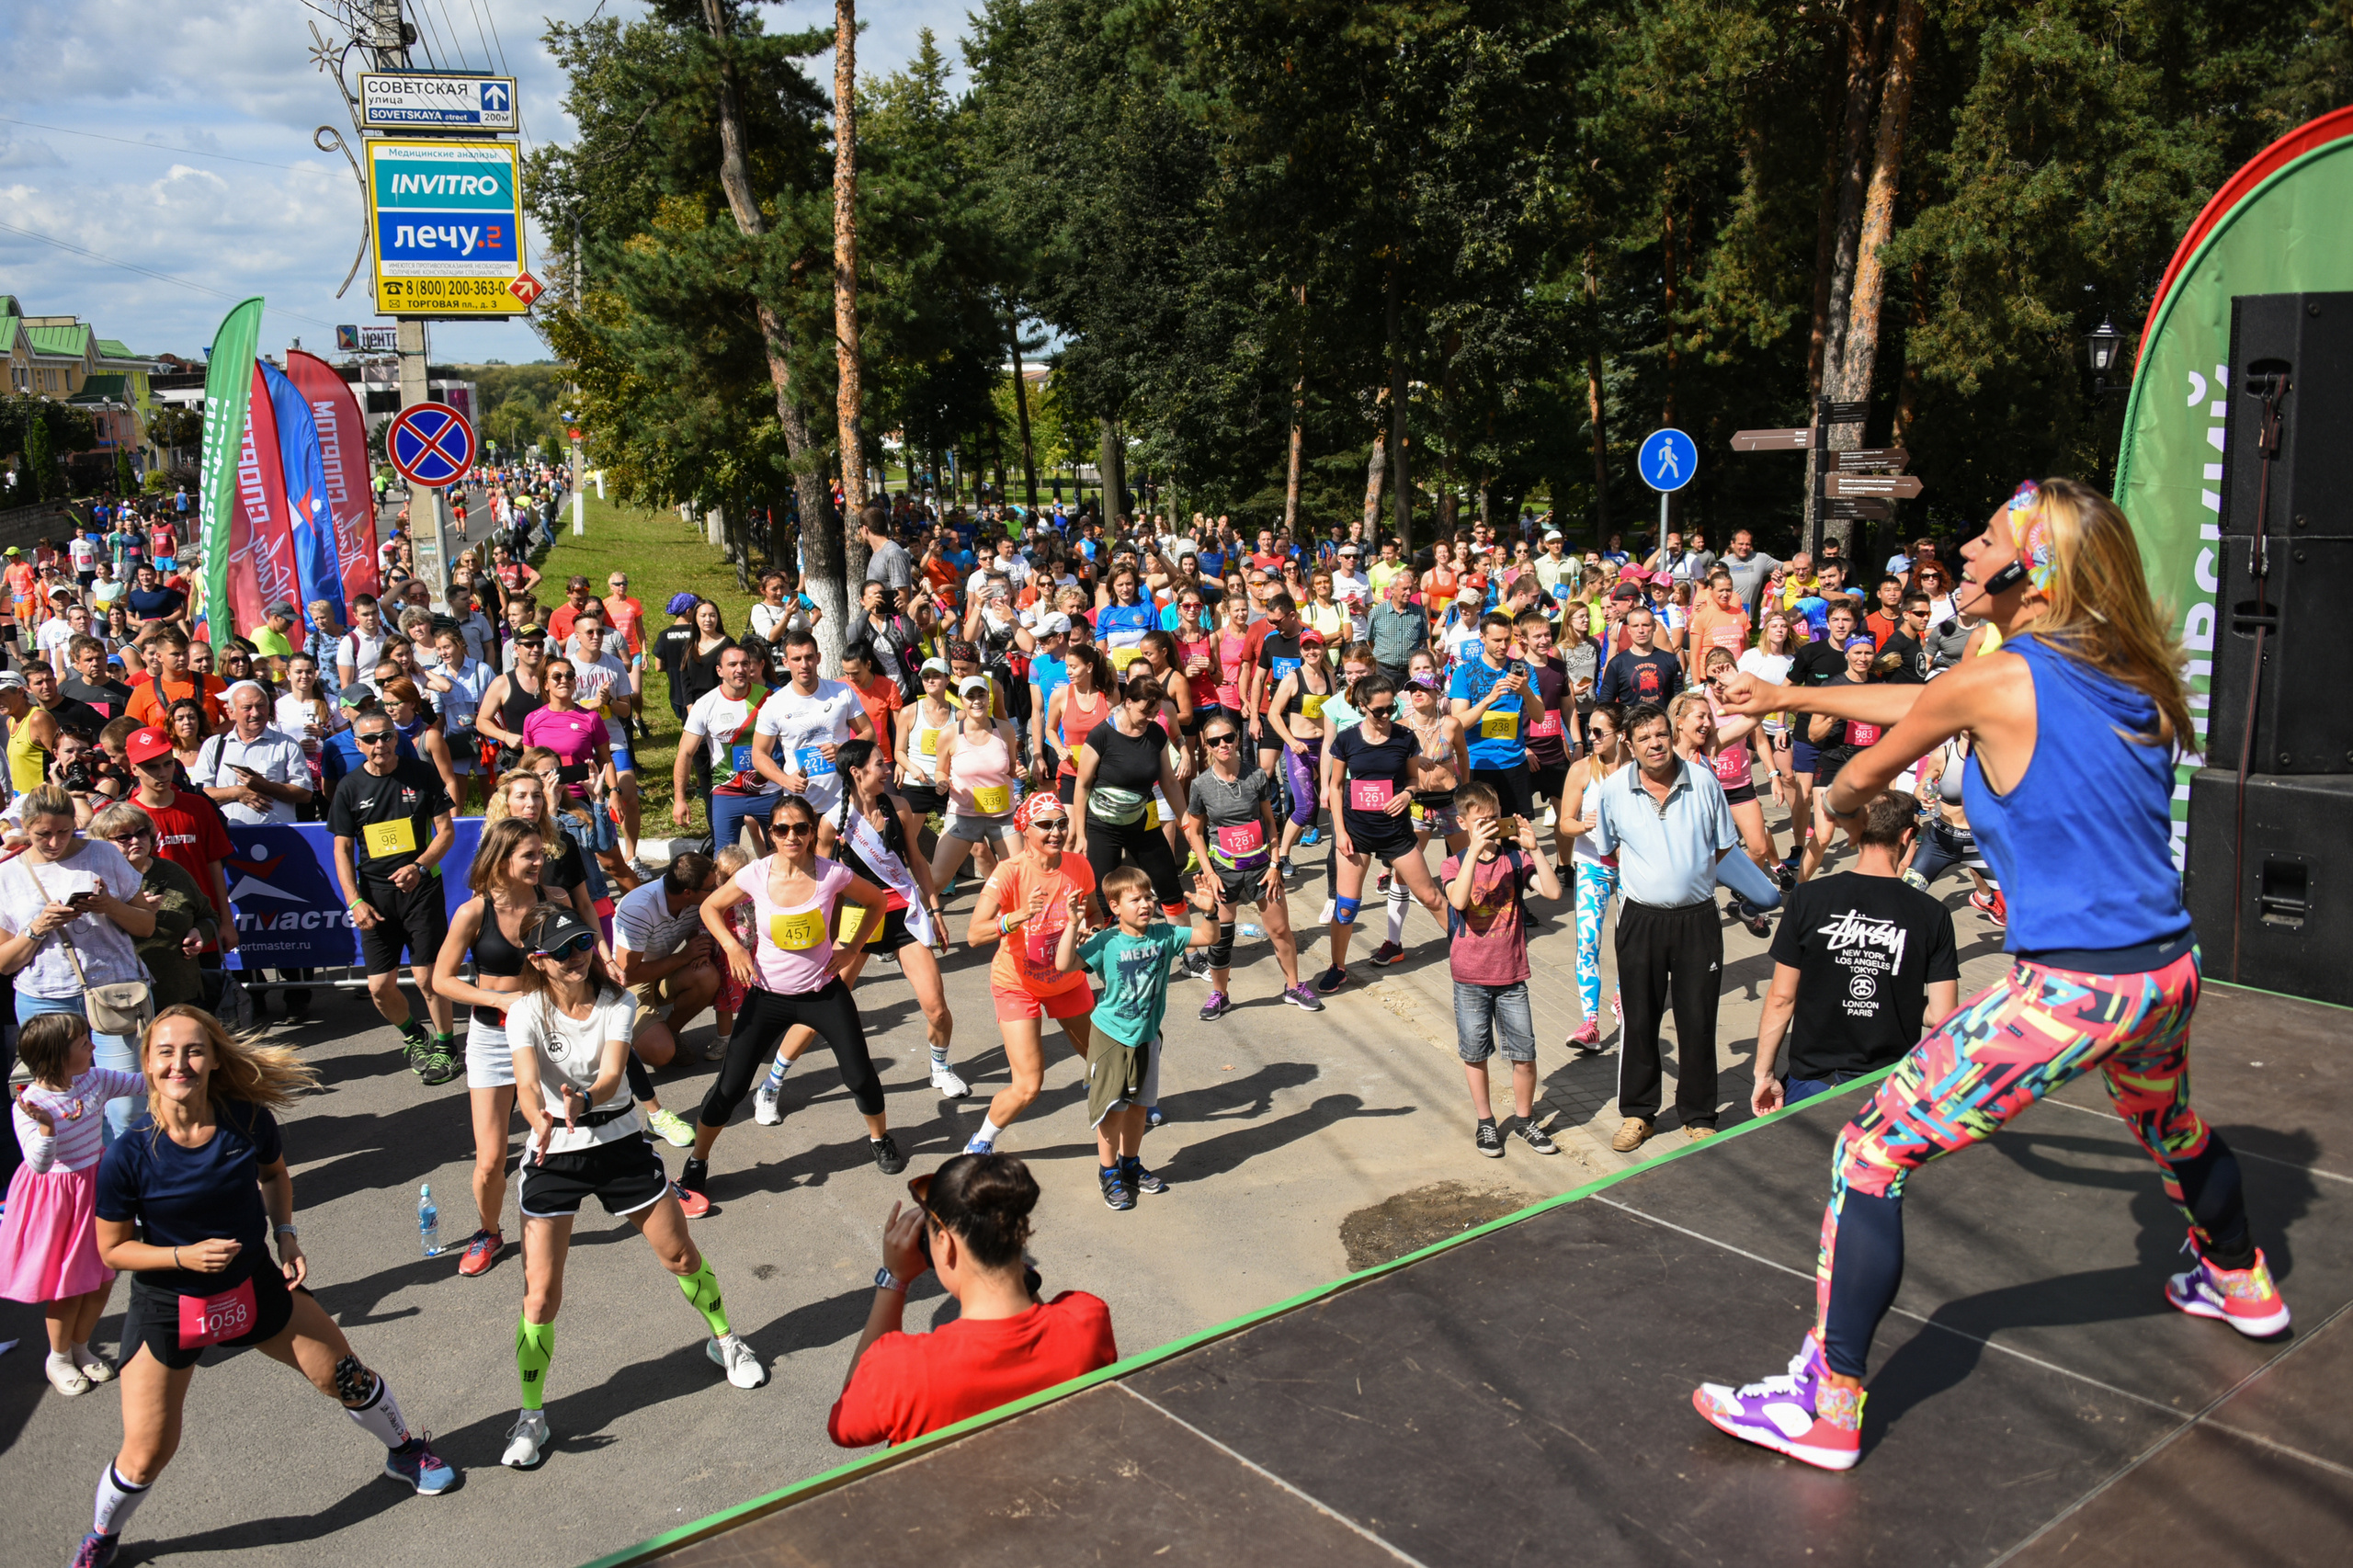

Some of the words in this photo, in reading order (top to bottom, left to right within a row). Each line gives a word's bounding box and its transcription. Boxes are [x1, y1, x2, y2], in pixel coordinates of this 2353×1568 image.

[368, 81, 468, 95] СОВЕТСКАЯ
[368, 96, 403, 106] улица
[370, 109, 442, 120] SOVETSKAYA
[445, 113, 467, 121] street
[484, 113, 508, 121] 200м
[388, 147, 454, 159] Медицинские
[457, 150, 497, 160] анализы
[391, 173, 498, 196] INVITRO
[406, 280, 413, 295] 8
[415, 280, 446, 298] (800)
[449, 280, 506, 295] 200-363-0
[407, 300, 459, 308] ТОРГОВАЯ
[1465, 645, 1483, 655] 2091
[574, 673, 614, 690] PEOPLE
[1492, 722, 1510, 732] 238
[1855, 729, 1872, 739] 983
[983, 796, 1002, 807] 339
[1358, 791, 1384, 802] 1261
[381, 834, 398, 846] 98
[1227, 834, 1255, 847] 1281
[785, 926, 811, 940] 457
[1120, 945, 1158, 961] MEXX
[1842, 949, 1860, 958] NEW
[1862, 950, 1886, 960] YORK
[1835, 956, 1852, 965] LOS
[1853, 958, 1891, 971] ANGELES
[1849, 966, 1879, 975] TOKYO
[1842, 999, 1879, 1009] LONDON
[1847, 1008, 1873, 1017] PARIS
[196, 1303, 247, 1334] 1058
